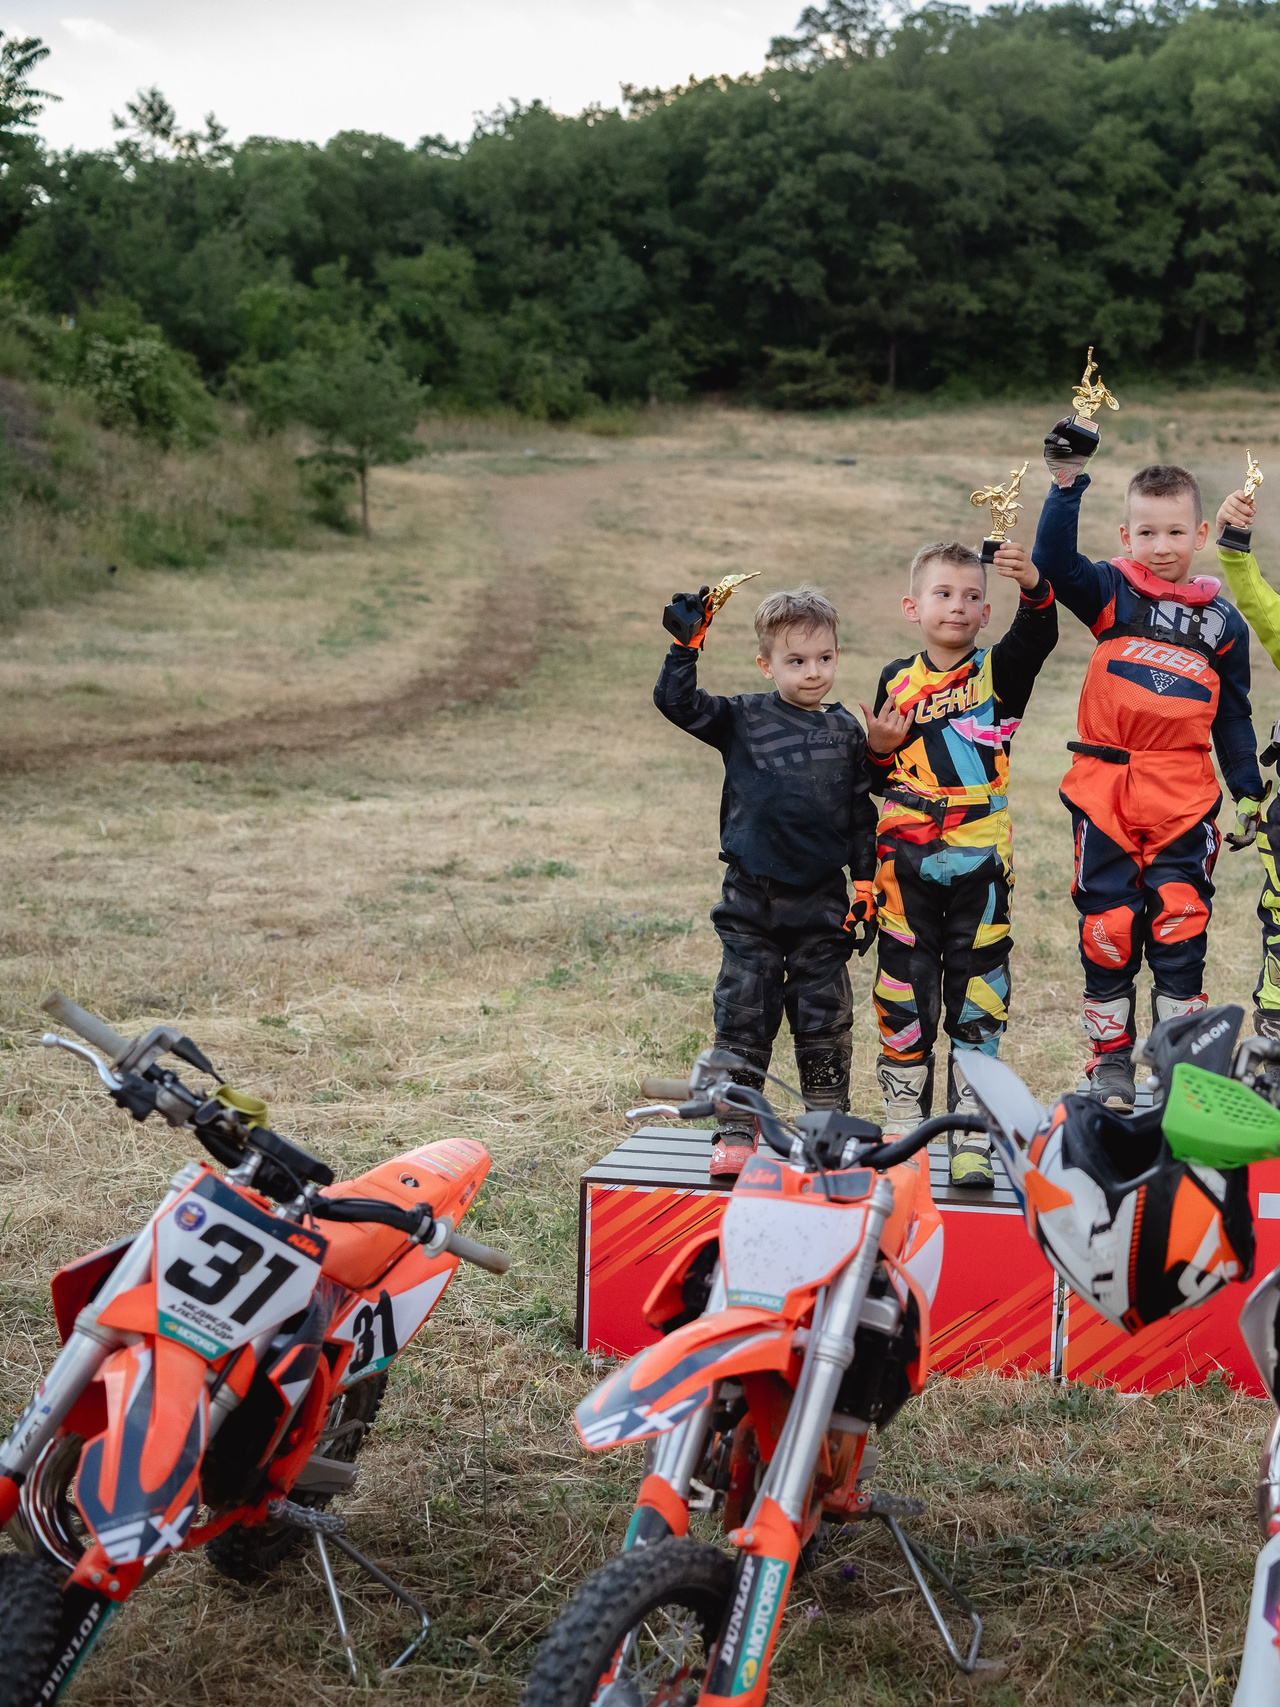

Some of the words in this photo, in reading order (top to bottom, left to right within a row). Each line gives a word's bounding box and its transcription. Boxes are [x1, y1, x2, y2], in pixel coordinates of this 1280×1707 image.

[1190, 1019, 1231, 1055] AIROH
[164, 1223, 300, 1327] 31
[348, 1289, 398, 1374] 31
[40, 1602, 101, 1700] DUNLOP
[720, 1555, 755, 1666] DUNLOP
[745, 1560, 785, 1658] MOTOREX
